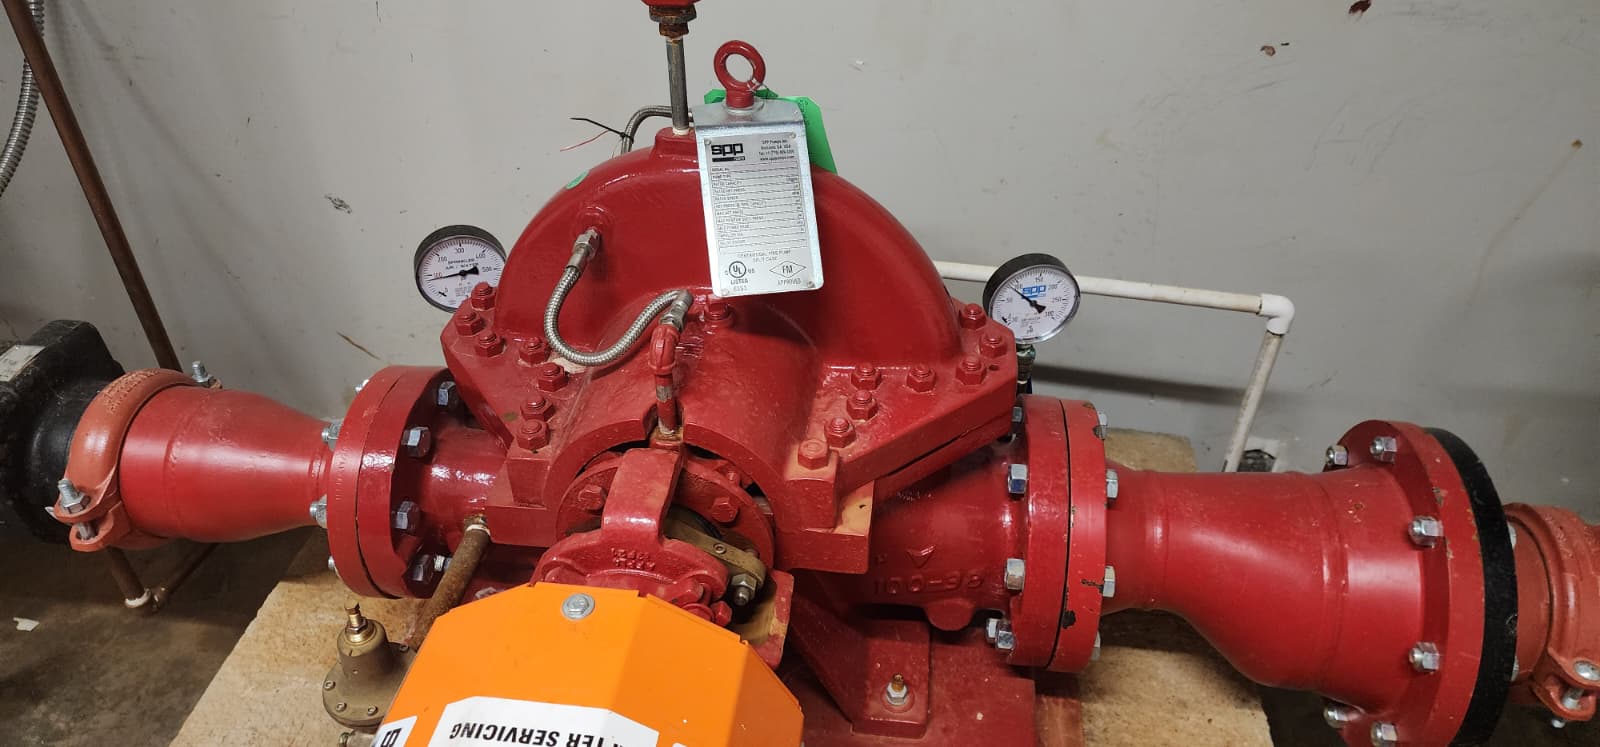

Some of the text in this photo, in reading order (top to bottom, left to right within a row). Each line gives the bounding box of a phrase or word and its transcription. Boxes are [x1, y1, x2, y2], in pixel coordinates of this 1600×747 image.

[711, 143, 744, 156] spp
[733, 265, 742, 275] UL
[782, 265, 793, 274] FM
[1023, 285, 1046, 295] spp
[449, 723, 561, 747] SERVICING
